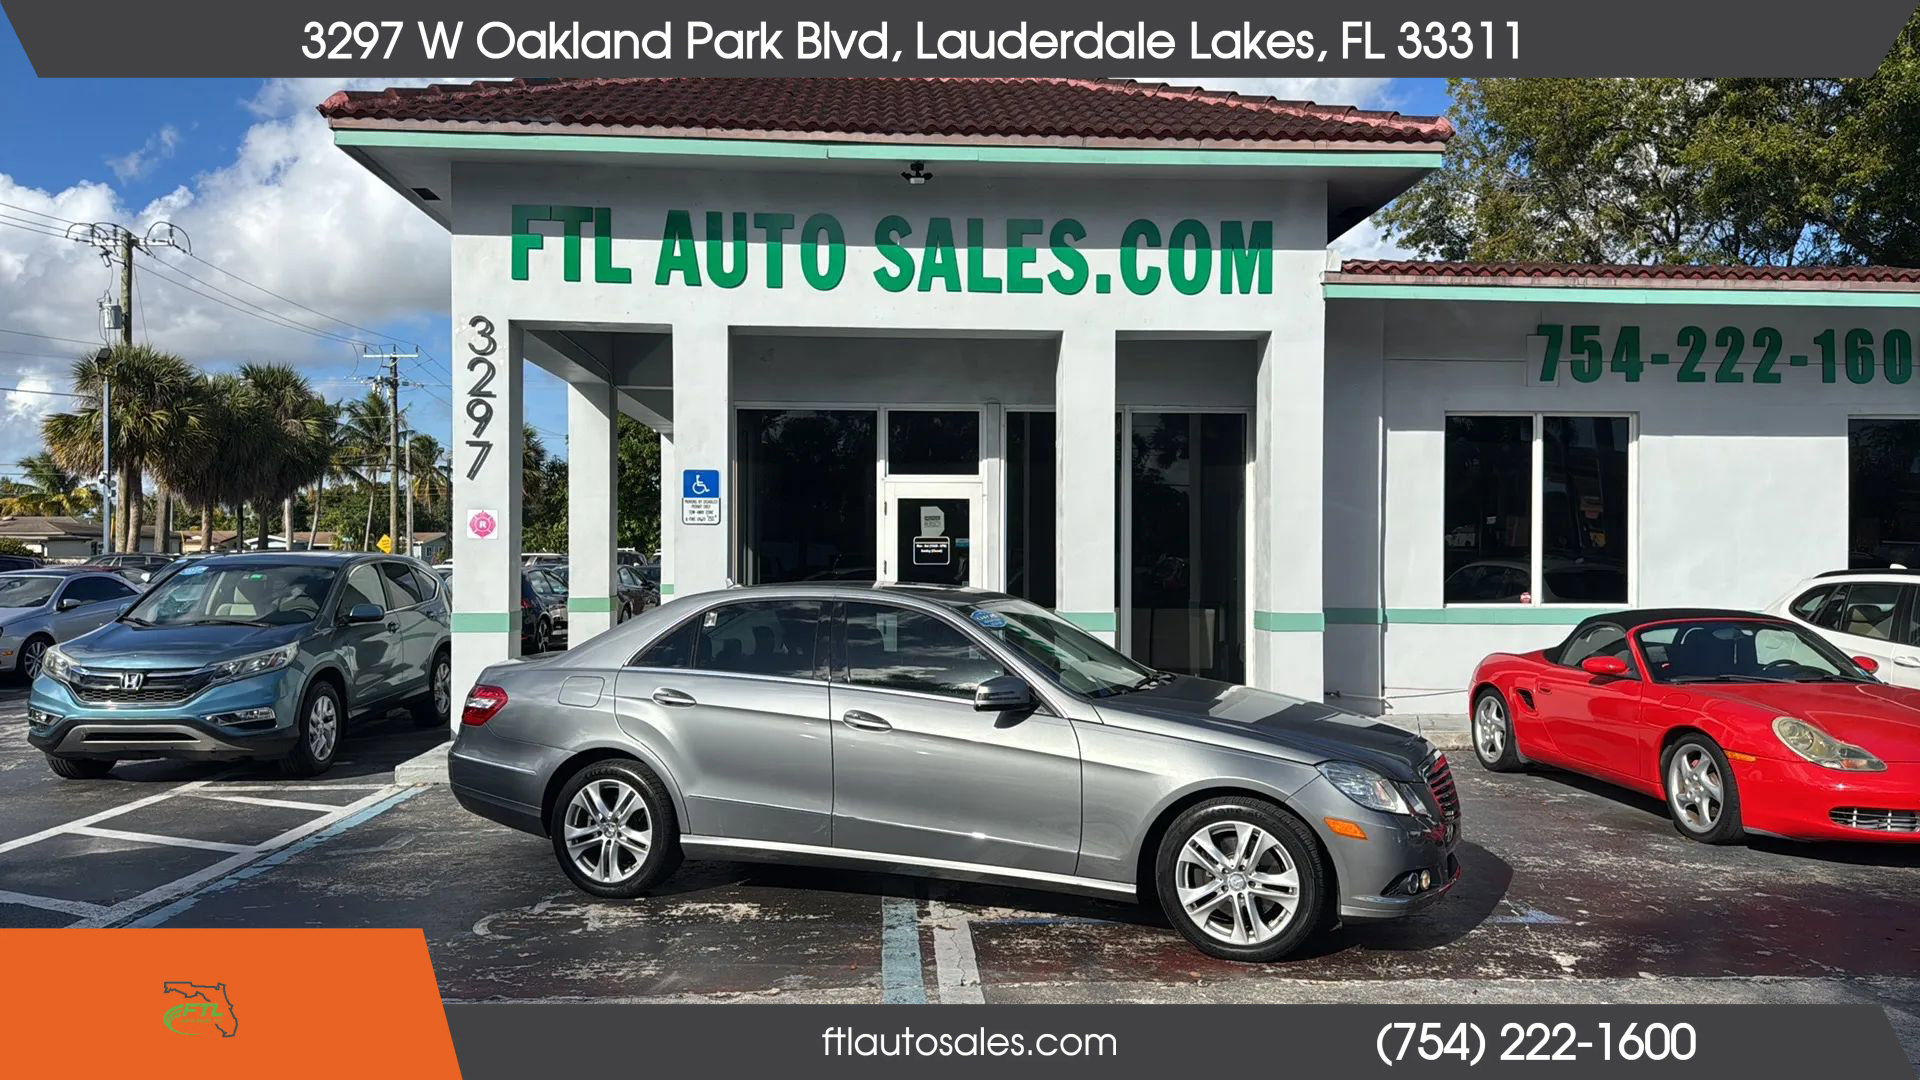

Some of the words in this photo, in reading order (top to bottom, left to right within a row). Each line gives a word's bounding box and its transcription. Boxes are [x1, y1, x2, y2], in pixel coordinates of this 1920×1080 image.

[511, 204, 632, 284] FTL
[655, 209, 847, 292] AUTO
[872, 214, 1275, 297] SALES.COM
[465, 315, 498, 481] 3297
[1537, 324, 1920, 385] 754-222-160
